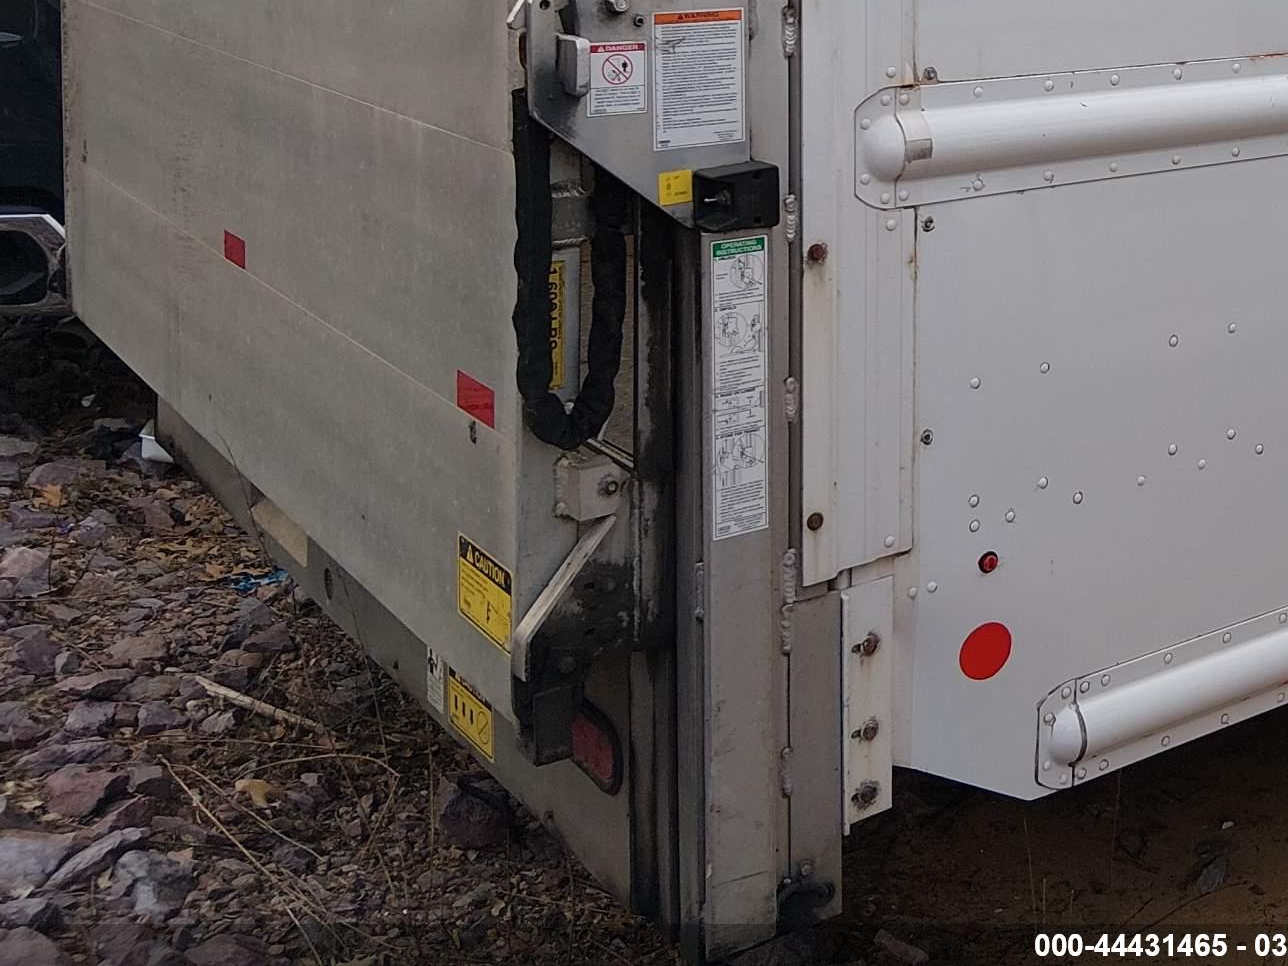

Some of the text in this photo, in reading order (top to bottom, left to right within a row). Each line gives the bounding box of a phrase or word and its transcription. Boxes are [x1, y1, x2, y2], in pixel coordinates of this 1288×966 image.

[684, 12, 720, 20] WARNING
[606, 44, 639, 52] DANGER
[715, 244, 763, 256] INSTRUCTIONS
[720, 239, 758, 250] OPERATING
[474, 550, 505, 587] CAUTION
